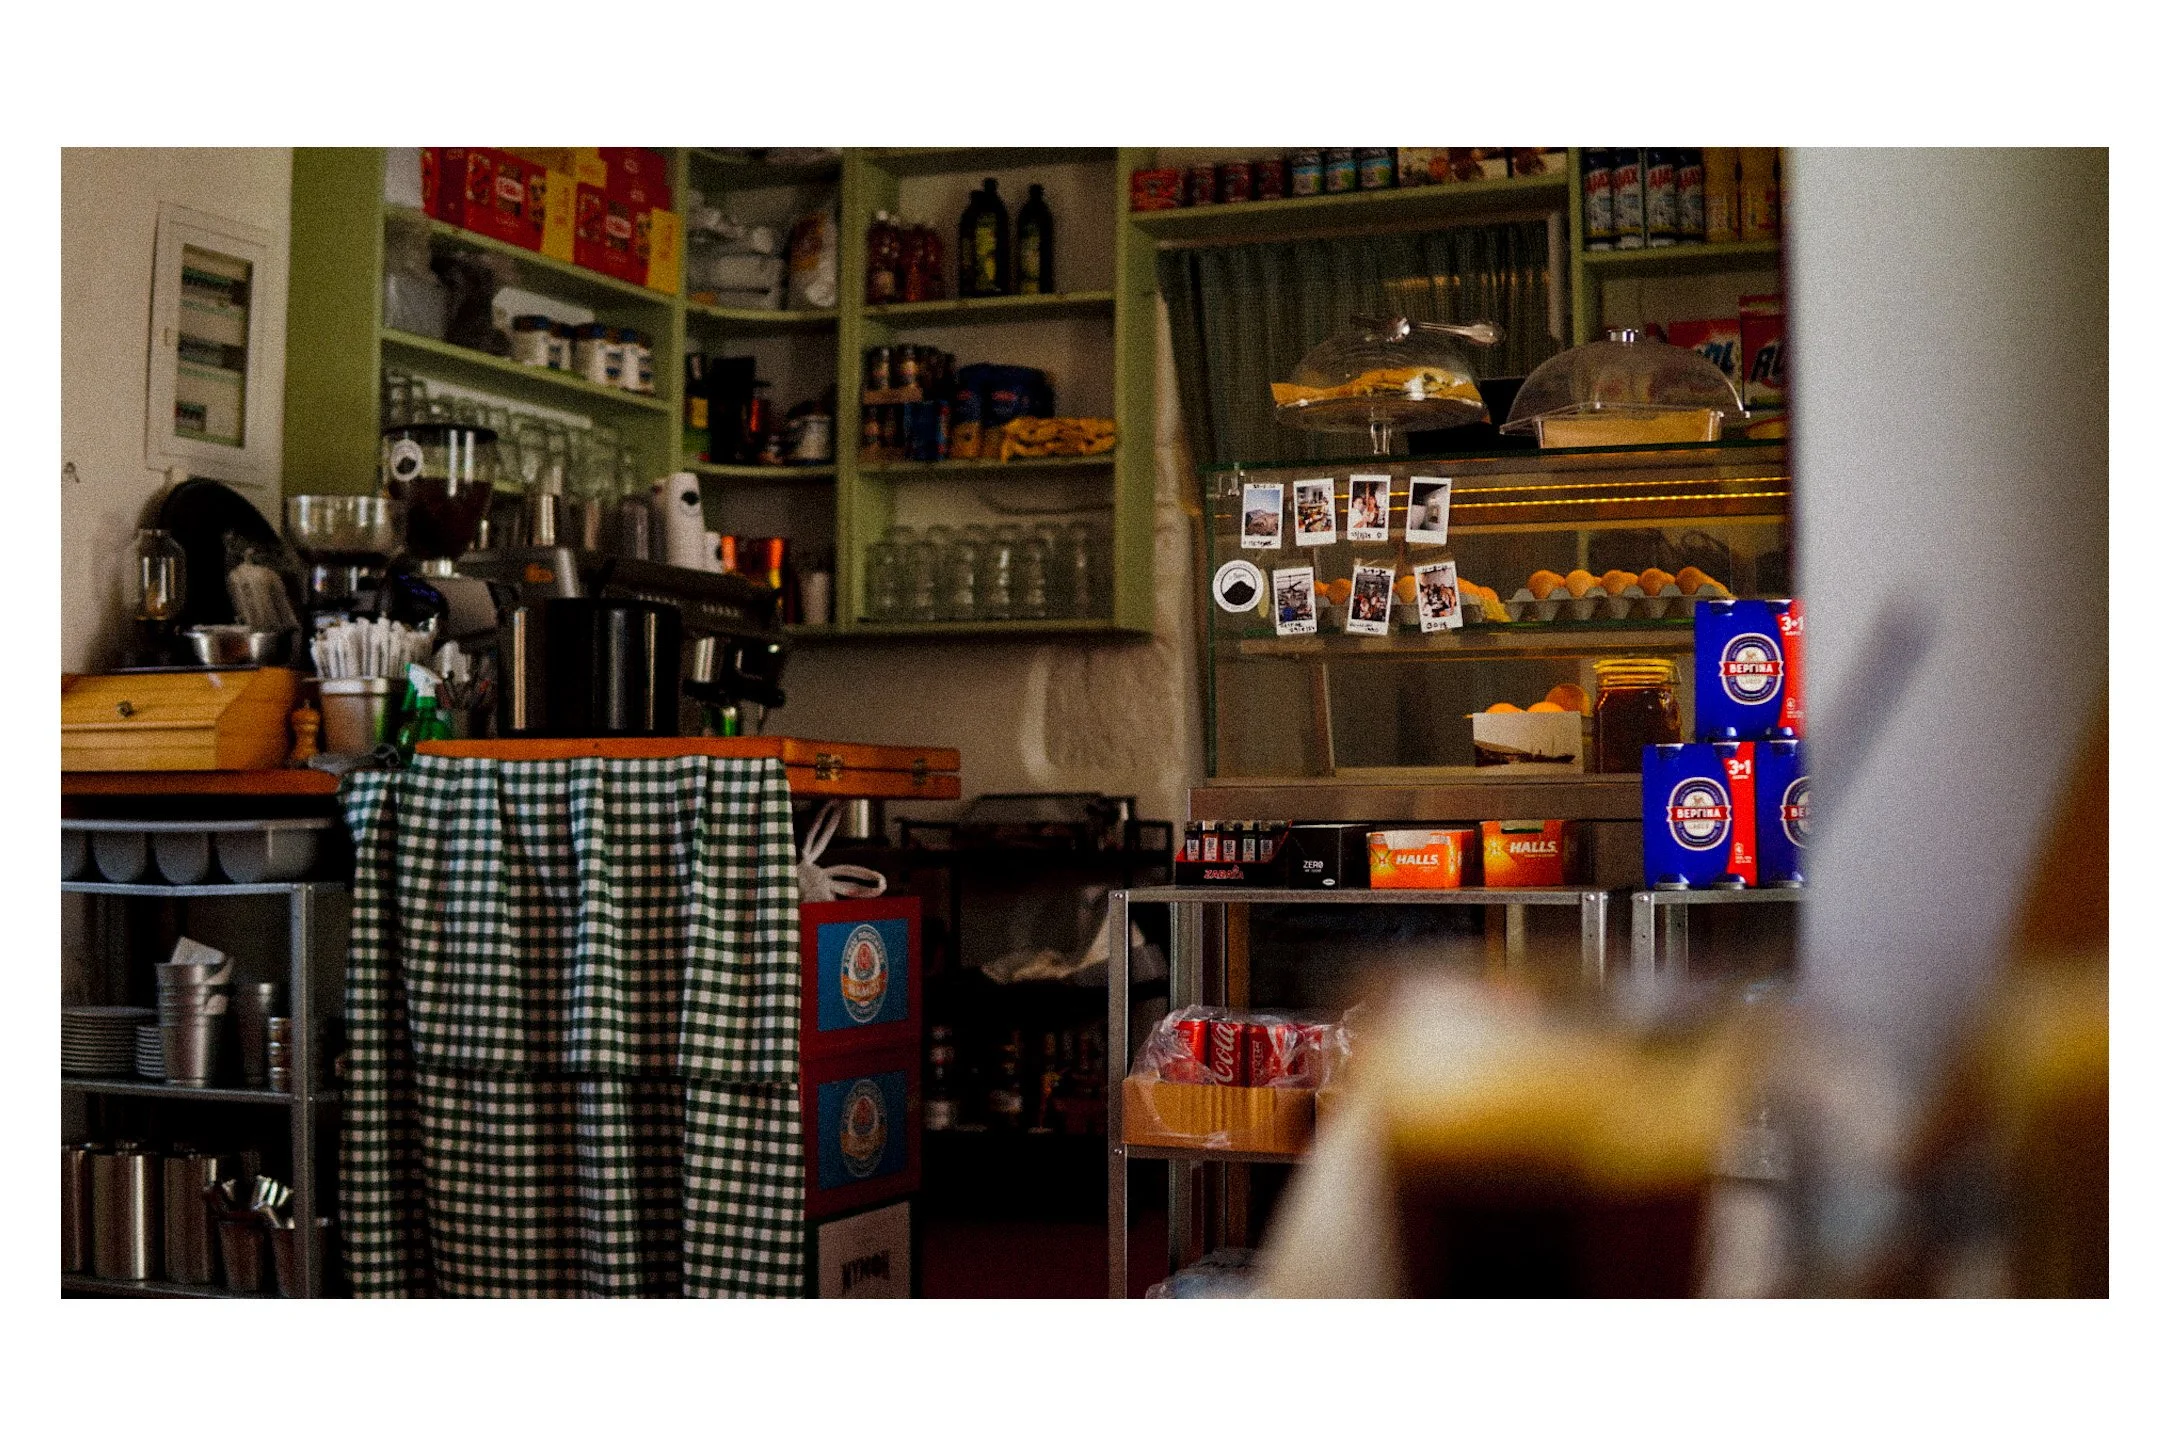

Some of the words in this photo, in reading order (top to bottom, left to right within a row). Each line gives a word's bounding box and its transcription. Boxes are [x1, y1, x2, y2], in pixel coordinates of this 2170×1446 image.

[1781, 616, 1804, 631] 3+1
[1729, 663, 1774, 674] ΒΕΡΓΙΝΑ
[1728, 760, 1752, 775] 3+1
[1676, 808, 1721, 819] ΒΕΡΓΙΝΑ
[1509, 841, 1556, 854] HALLS
[1396, 854, 1438, 866] HALLS
[1214, 1023, 1236, 1084] Cola
